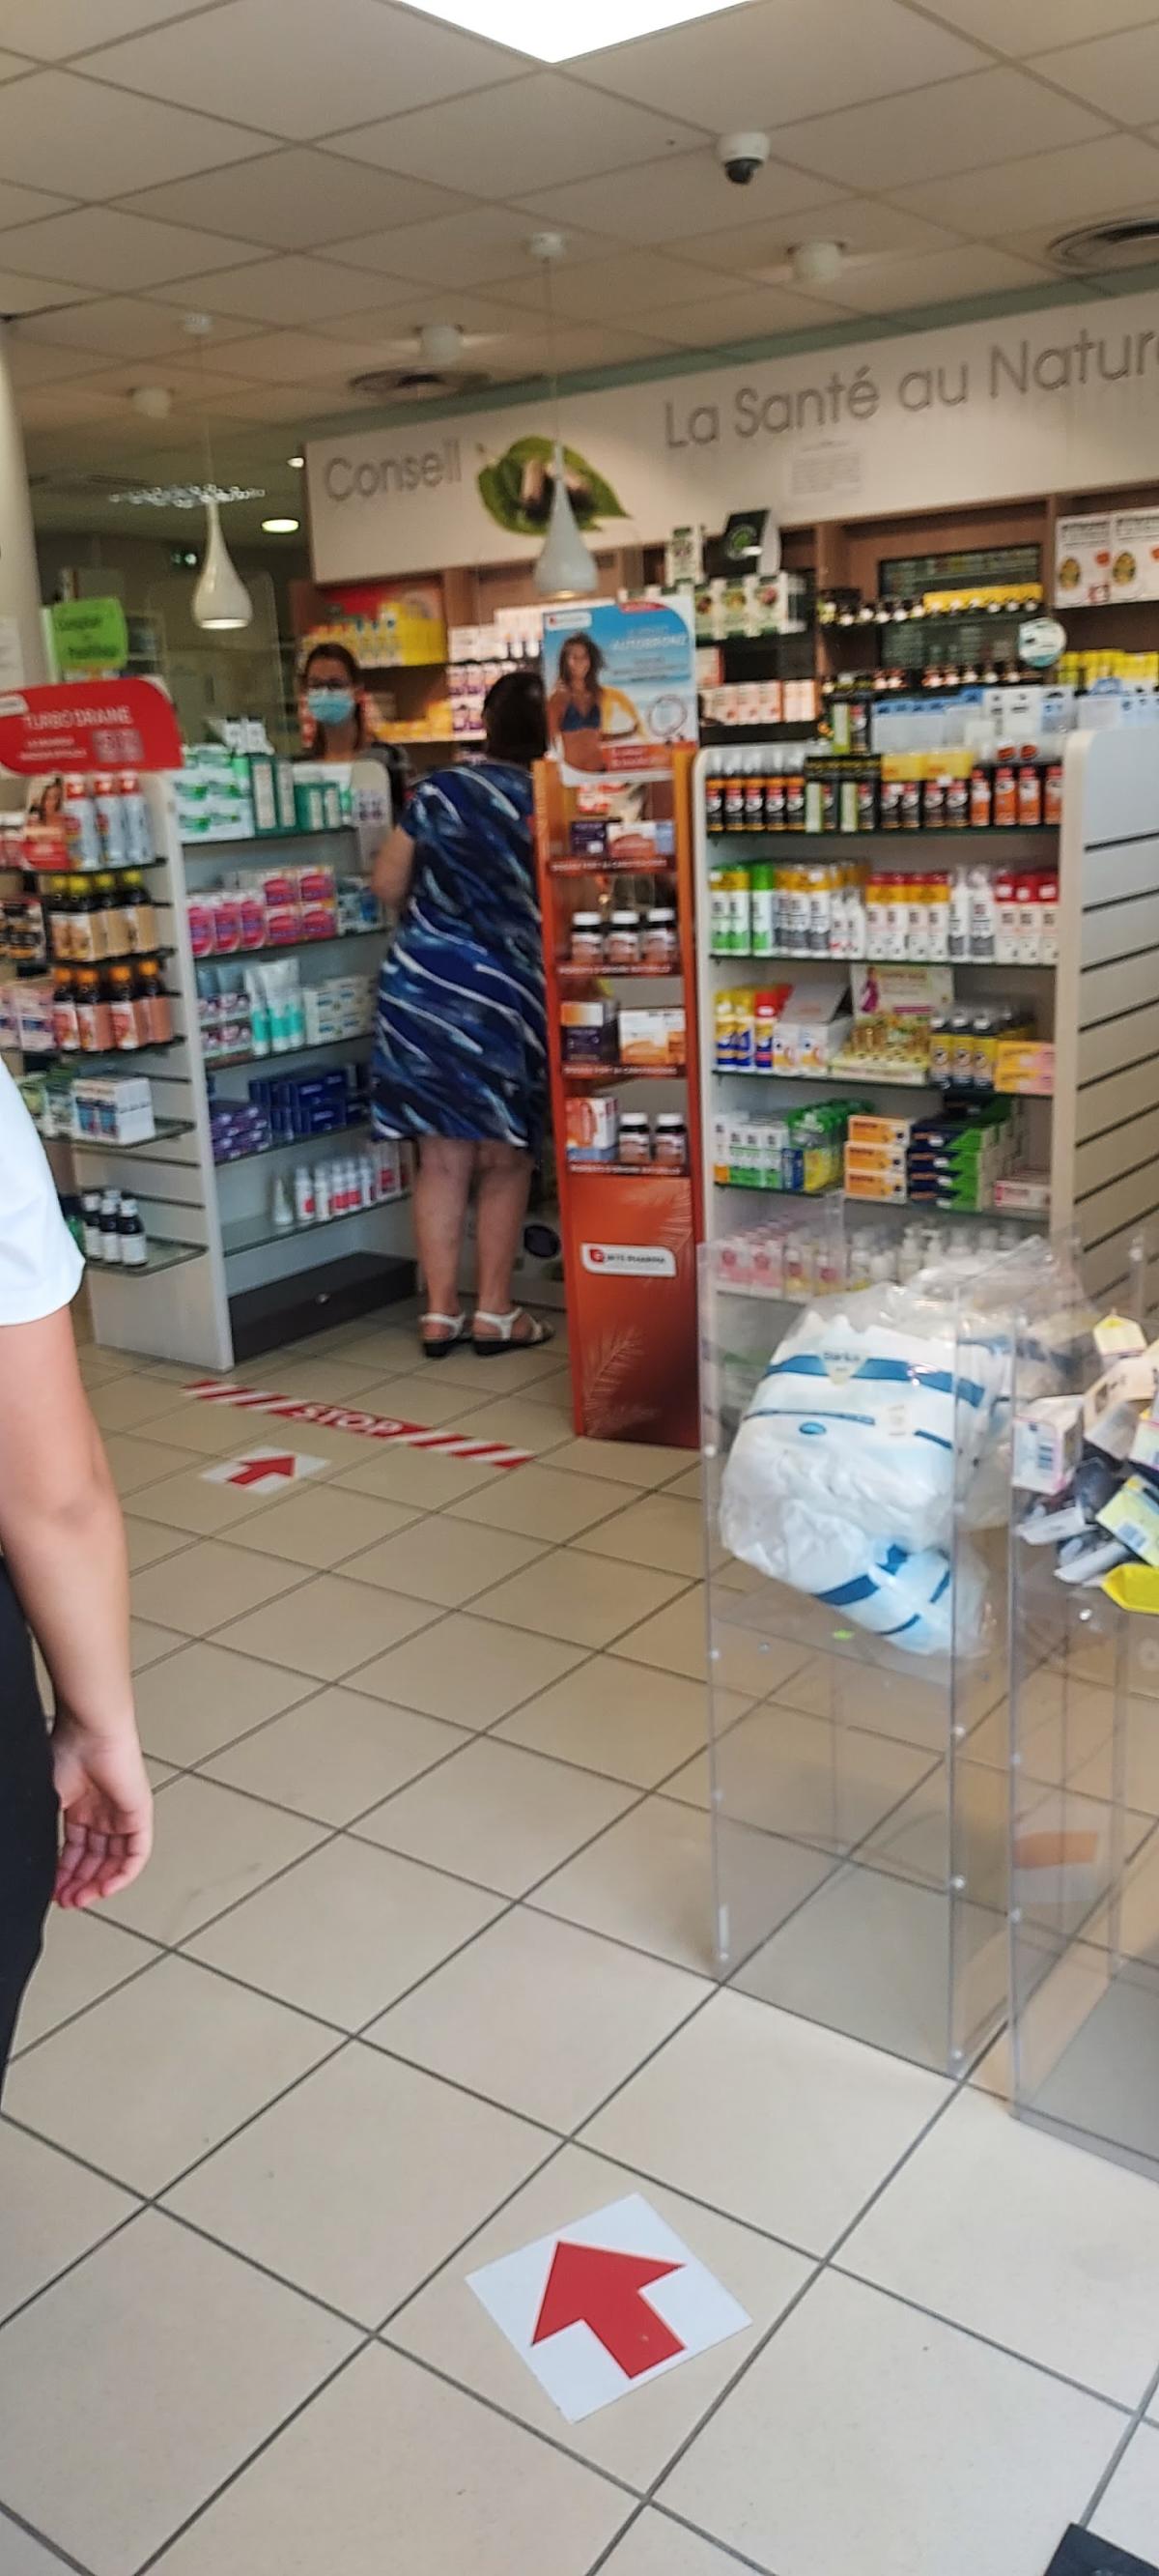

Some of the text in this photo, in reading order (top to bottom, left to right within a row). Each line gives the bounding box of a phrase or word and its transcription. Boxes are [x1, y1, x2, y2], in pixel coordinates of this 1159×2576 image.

[664, 328, 1159, 449] La Santé au Natur
[323, 437, 461, 501] Conseil
[289, 1404, 404, 1437] STOP
